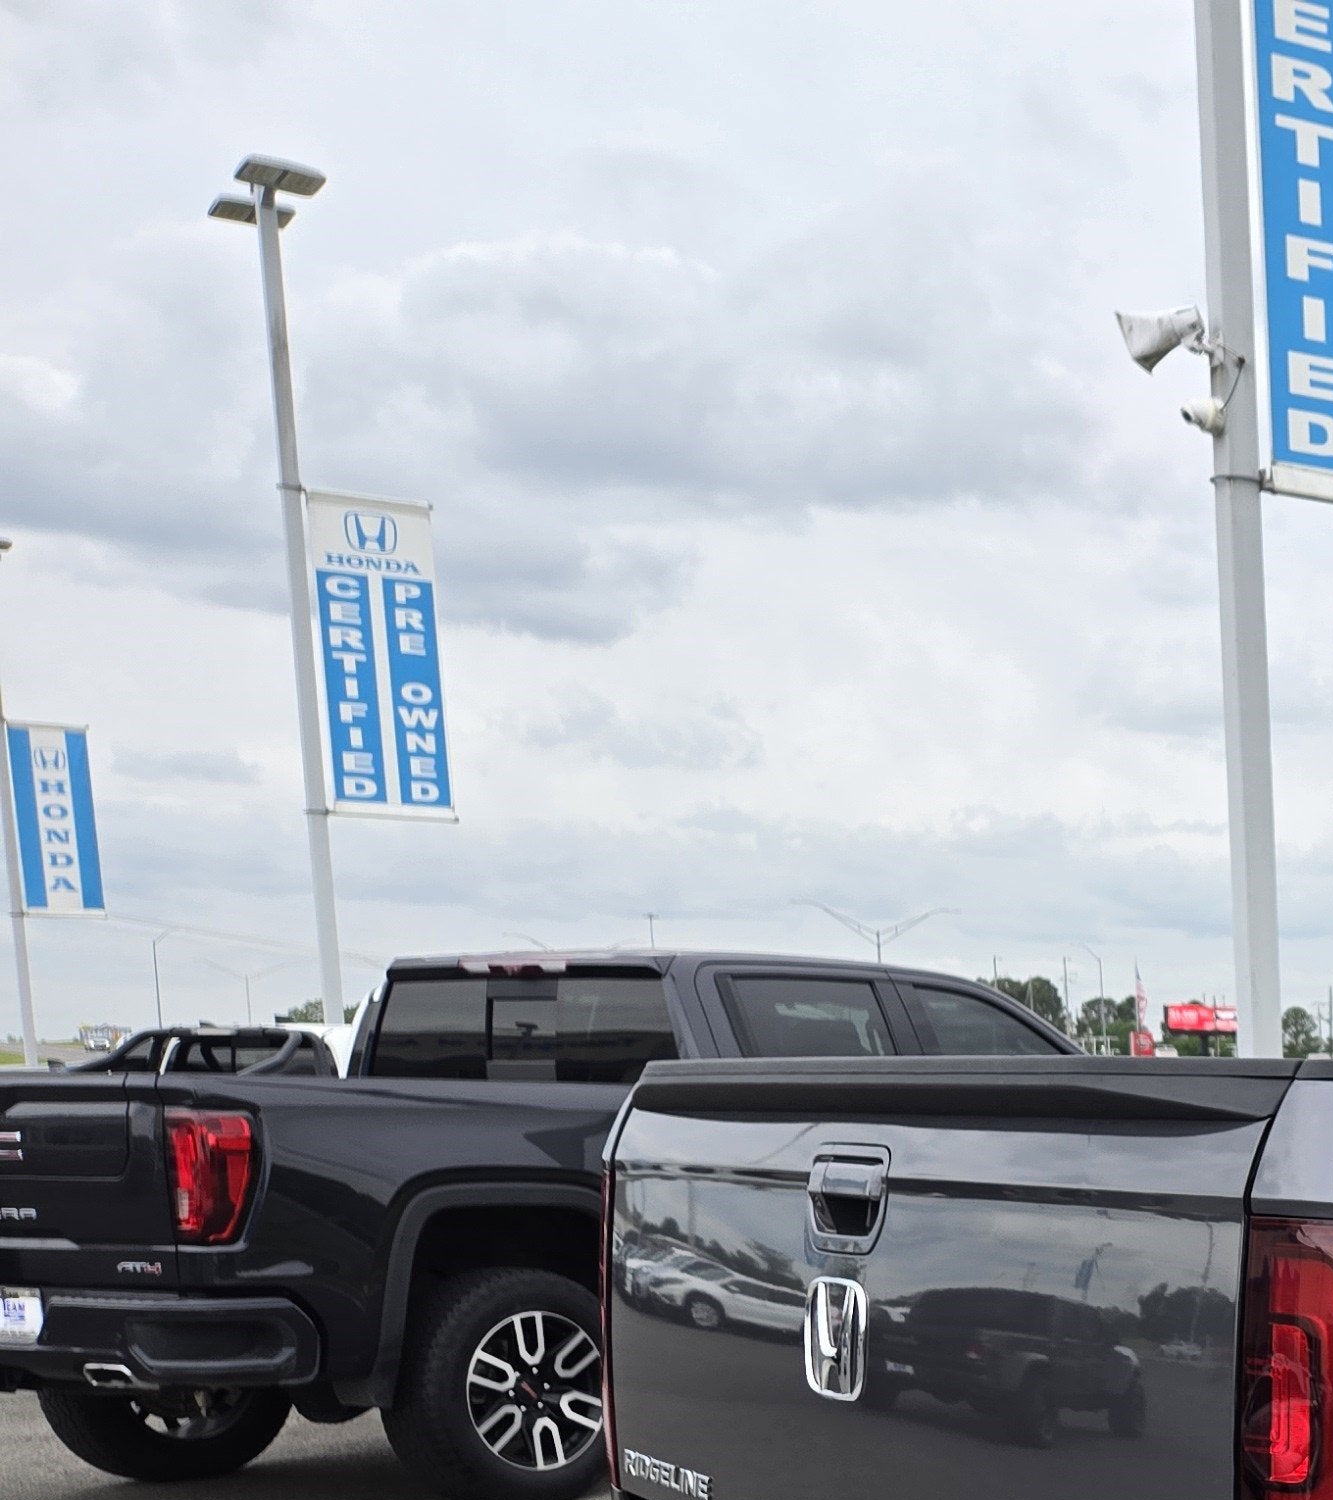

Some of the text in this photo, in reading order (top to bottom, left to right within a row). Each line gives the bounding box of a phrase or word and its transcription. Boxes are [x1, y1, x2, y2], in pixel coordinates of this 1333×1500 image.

[326, 553, 421, 575] HONDA
[325, 575, 378, 800] CERTIFIED
[394, 581, 440, 803] PRE OWNED
[39, 778, 78, 894] HONDA
[0, 1207, 37, 1221] RA
[116, 1261, 162, 1277] AT4
